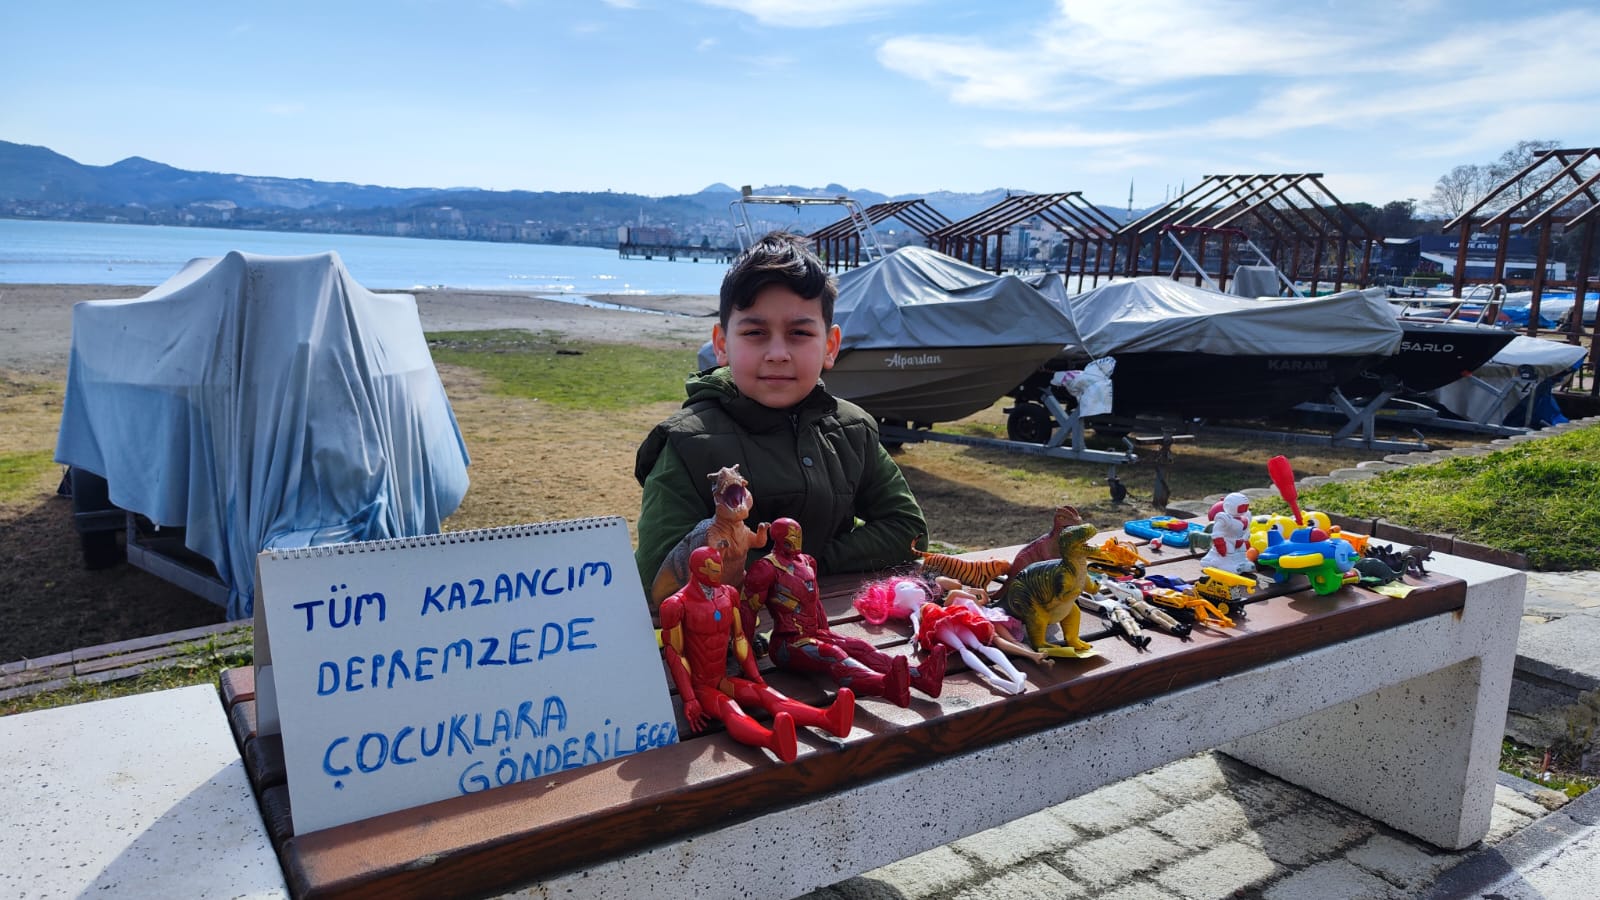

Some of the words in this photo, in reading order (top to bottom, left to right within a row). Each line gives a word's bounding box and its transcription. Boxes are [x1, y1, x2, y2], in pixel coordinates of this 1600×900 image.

[884, 353, 941, 369] Alparslan
[293, 583, 388, 632] TÜM
[421, 561, 613, 617] KAZANCIM
[316, 616, 598, 697] DEPREMZEDE
[321, 695, 568, 790] ÇOCUKLARA
